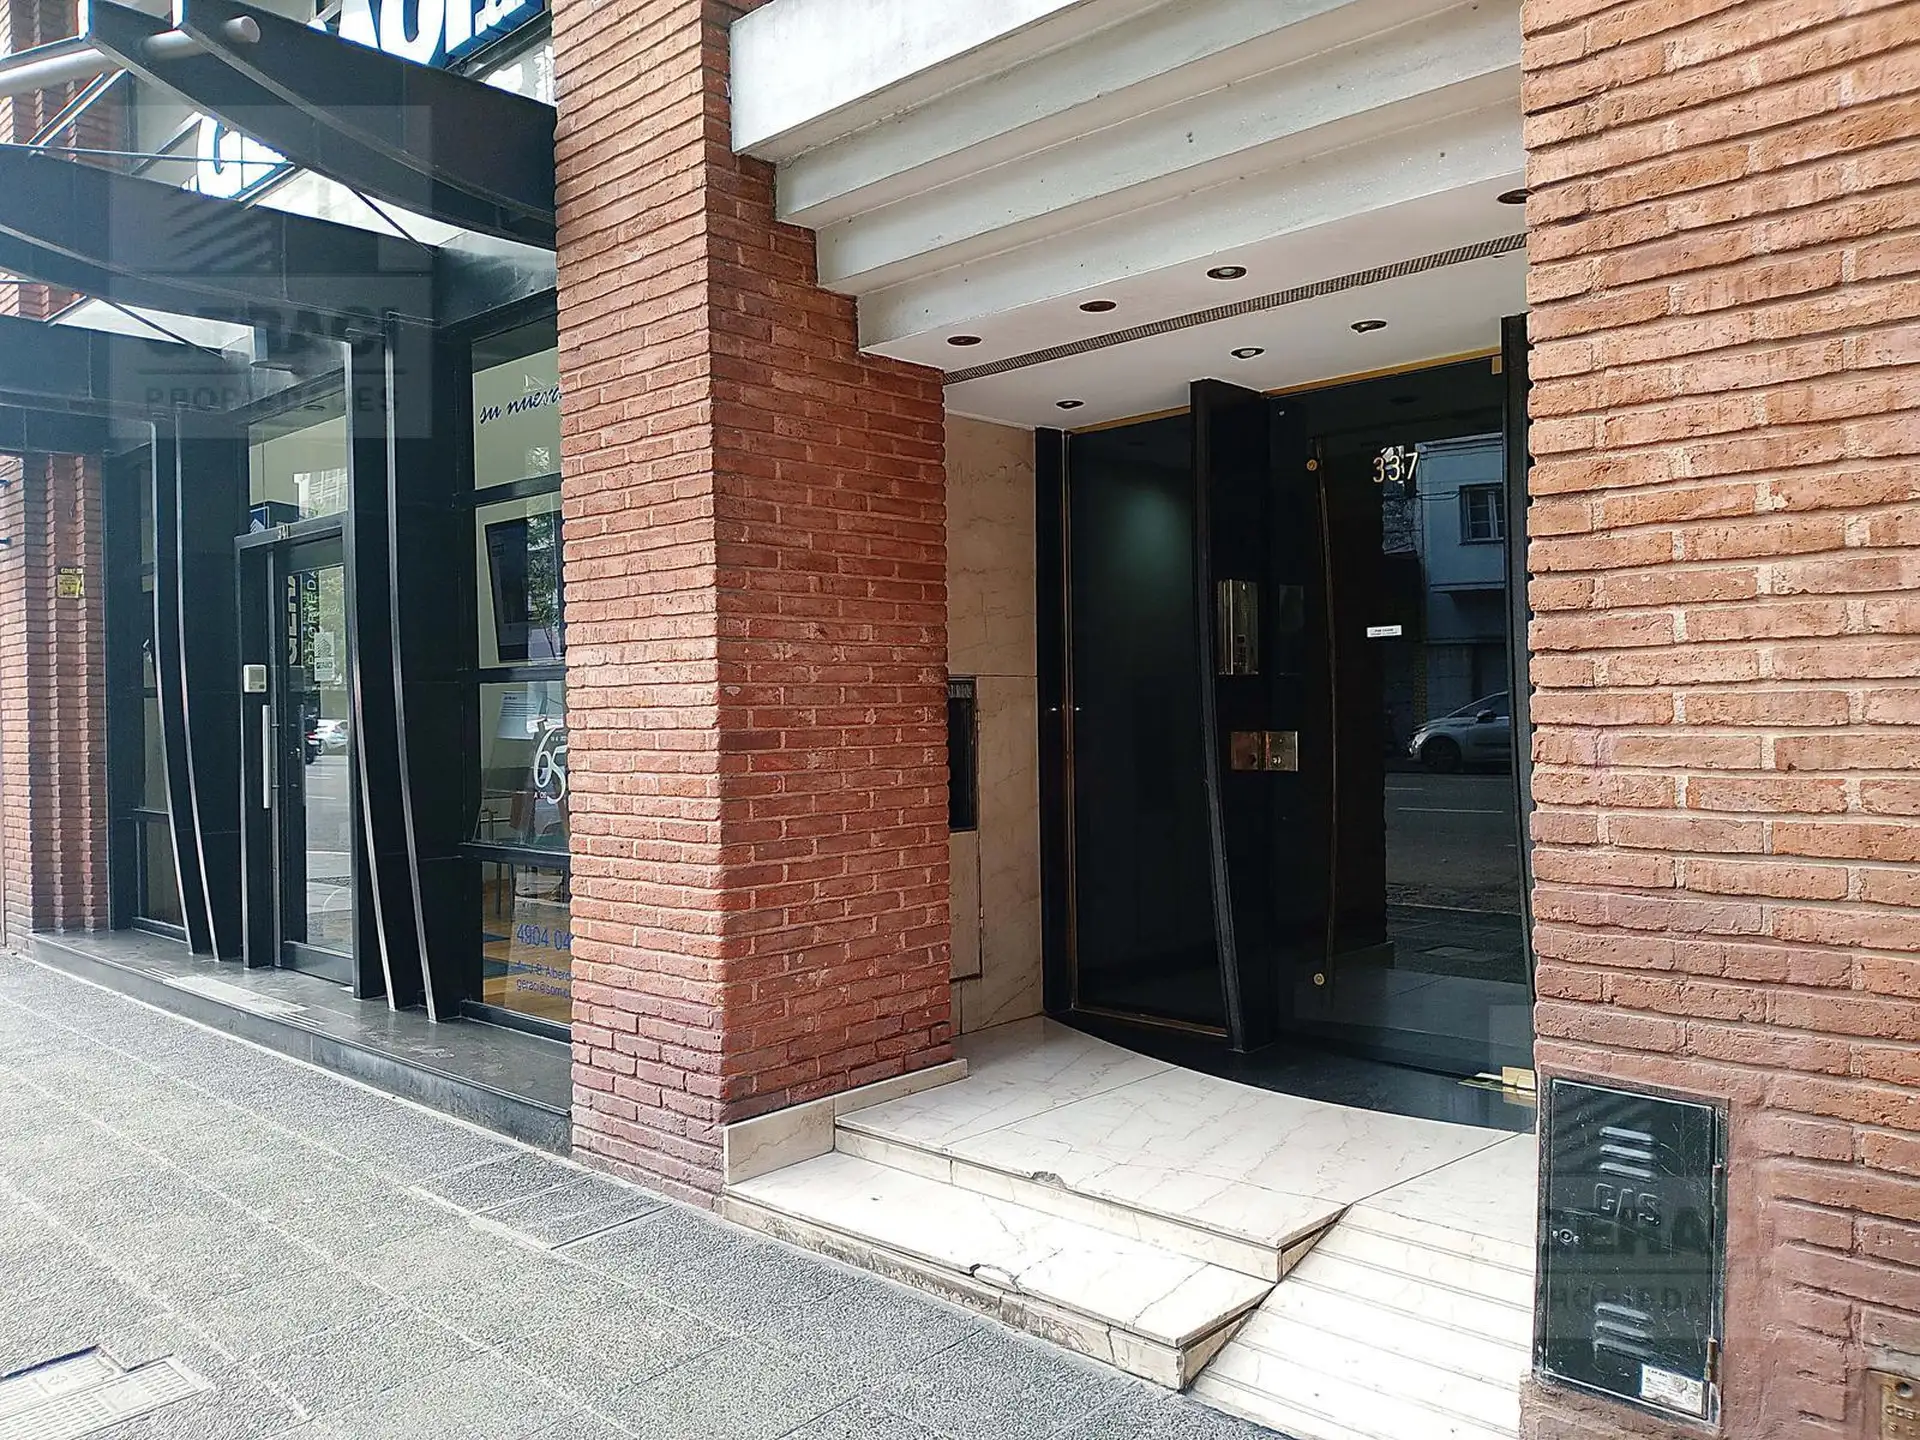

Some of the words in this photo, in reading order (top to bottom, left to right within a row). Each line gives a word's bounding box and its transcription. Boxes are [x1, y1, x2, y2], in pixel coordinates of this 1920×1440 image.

[480, 405, 501, 424] su
[1373, 452, 1418, 483] 337
[517, 924, 549, 946] 4904
[1594, 1183, 1661, 1226] GAS
